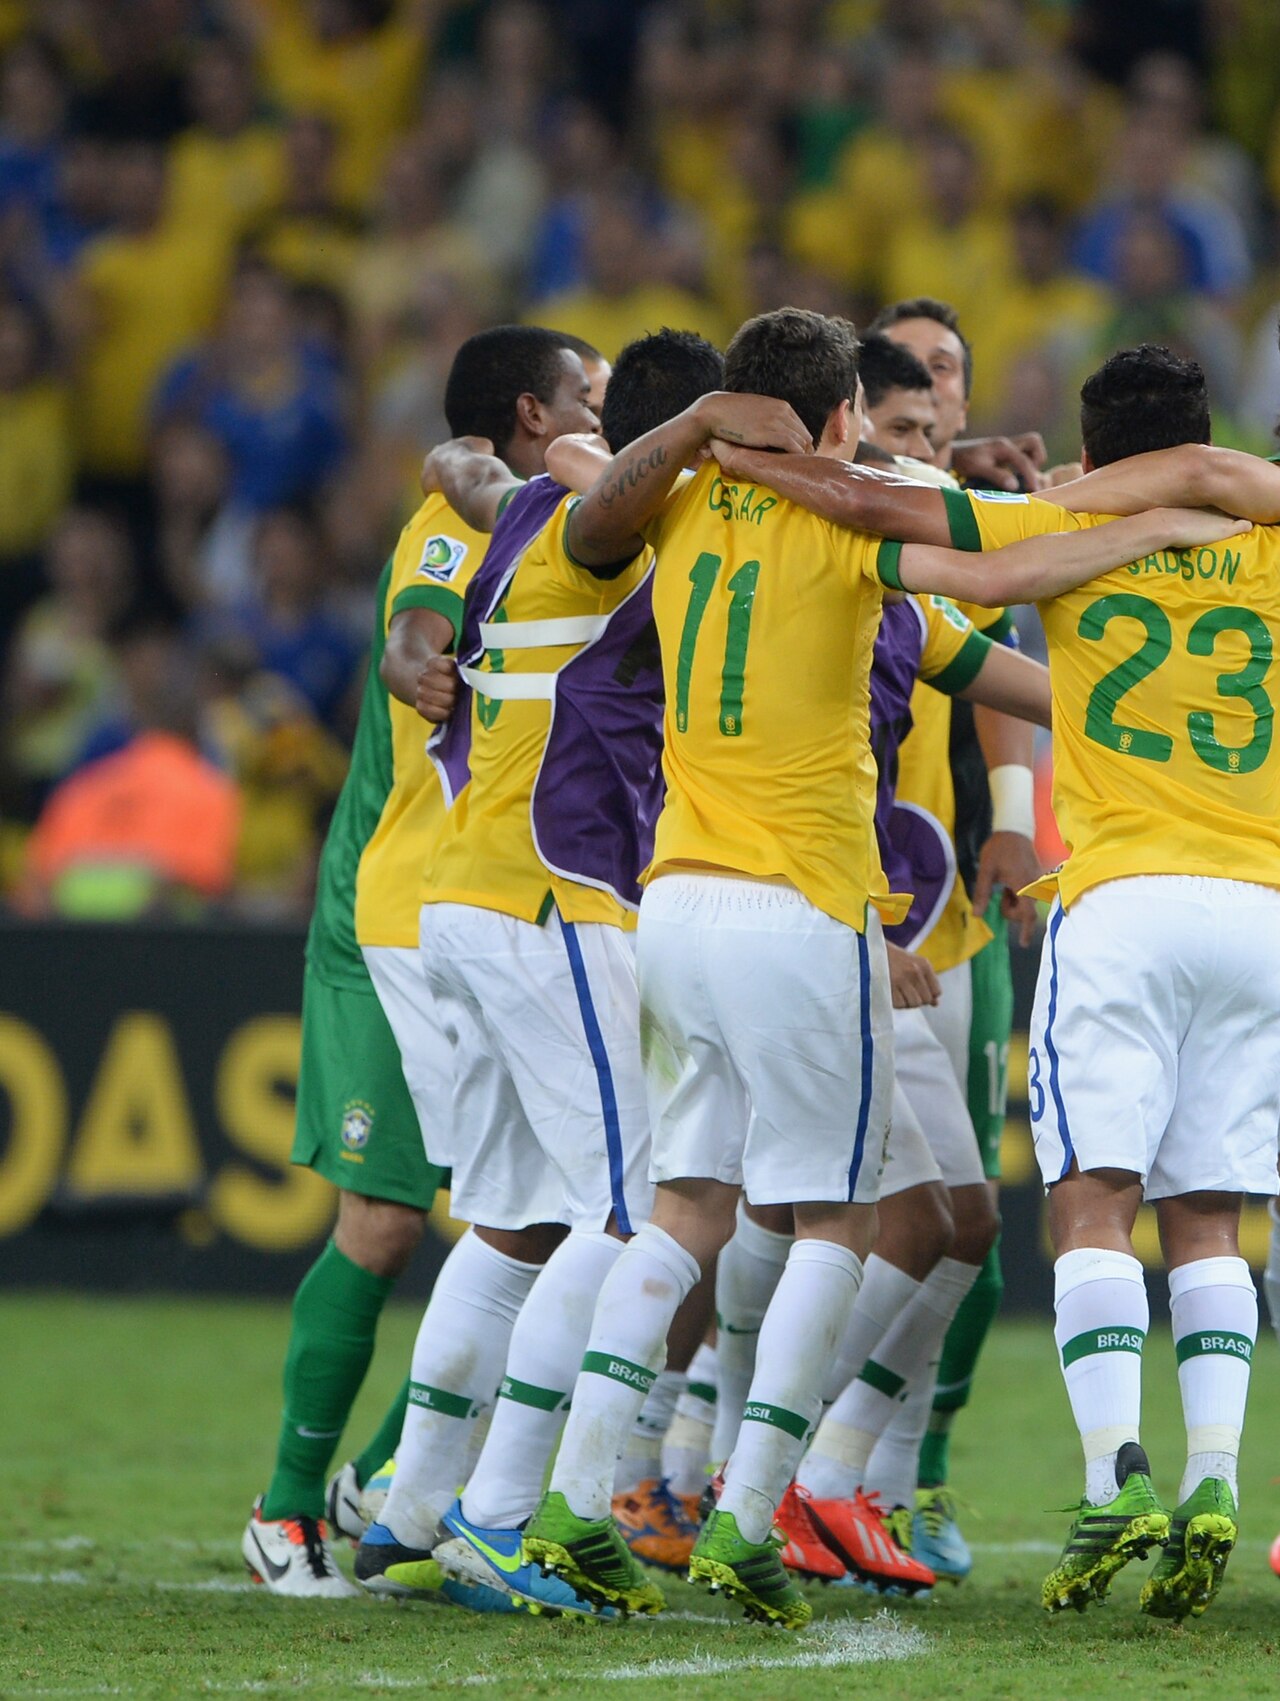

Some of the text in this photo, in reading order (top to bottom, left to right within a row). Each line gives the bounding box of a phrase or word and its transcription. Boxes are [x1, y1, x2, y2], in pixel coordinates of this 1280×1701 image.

[676, 552, 760, 737] 11
[1077, 593, 1274, 774] 23
[1201, 1337, 1251, 1360] BRASIL
